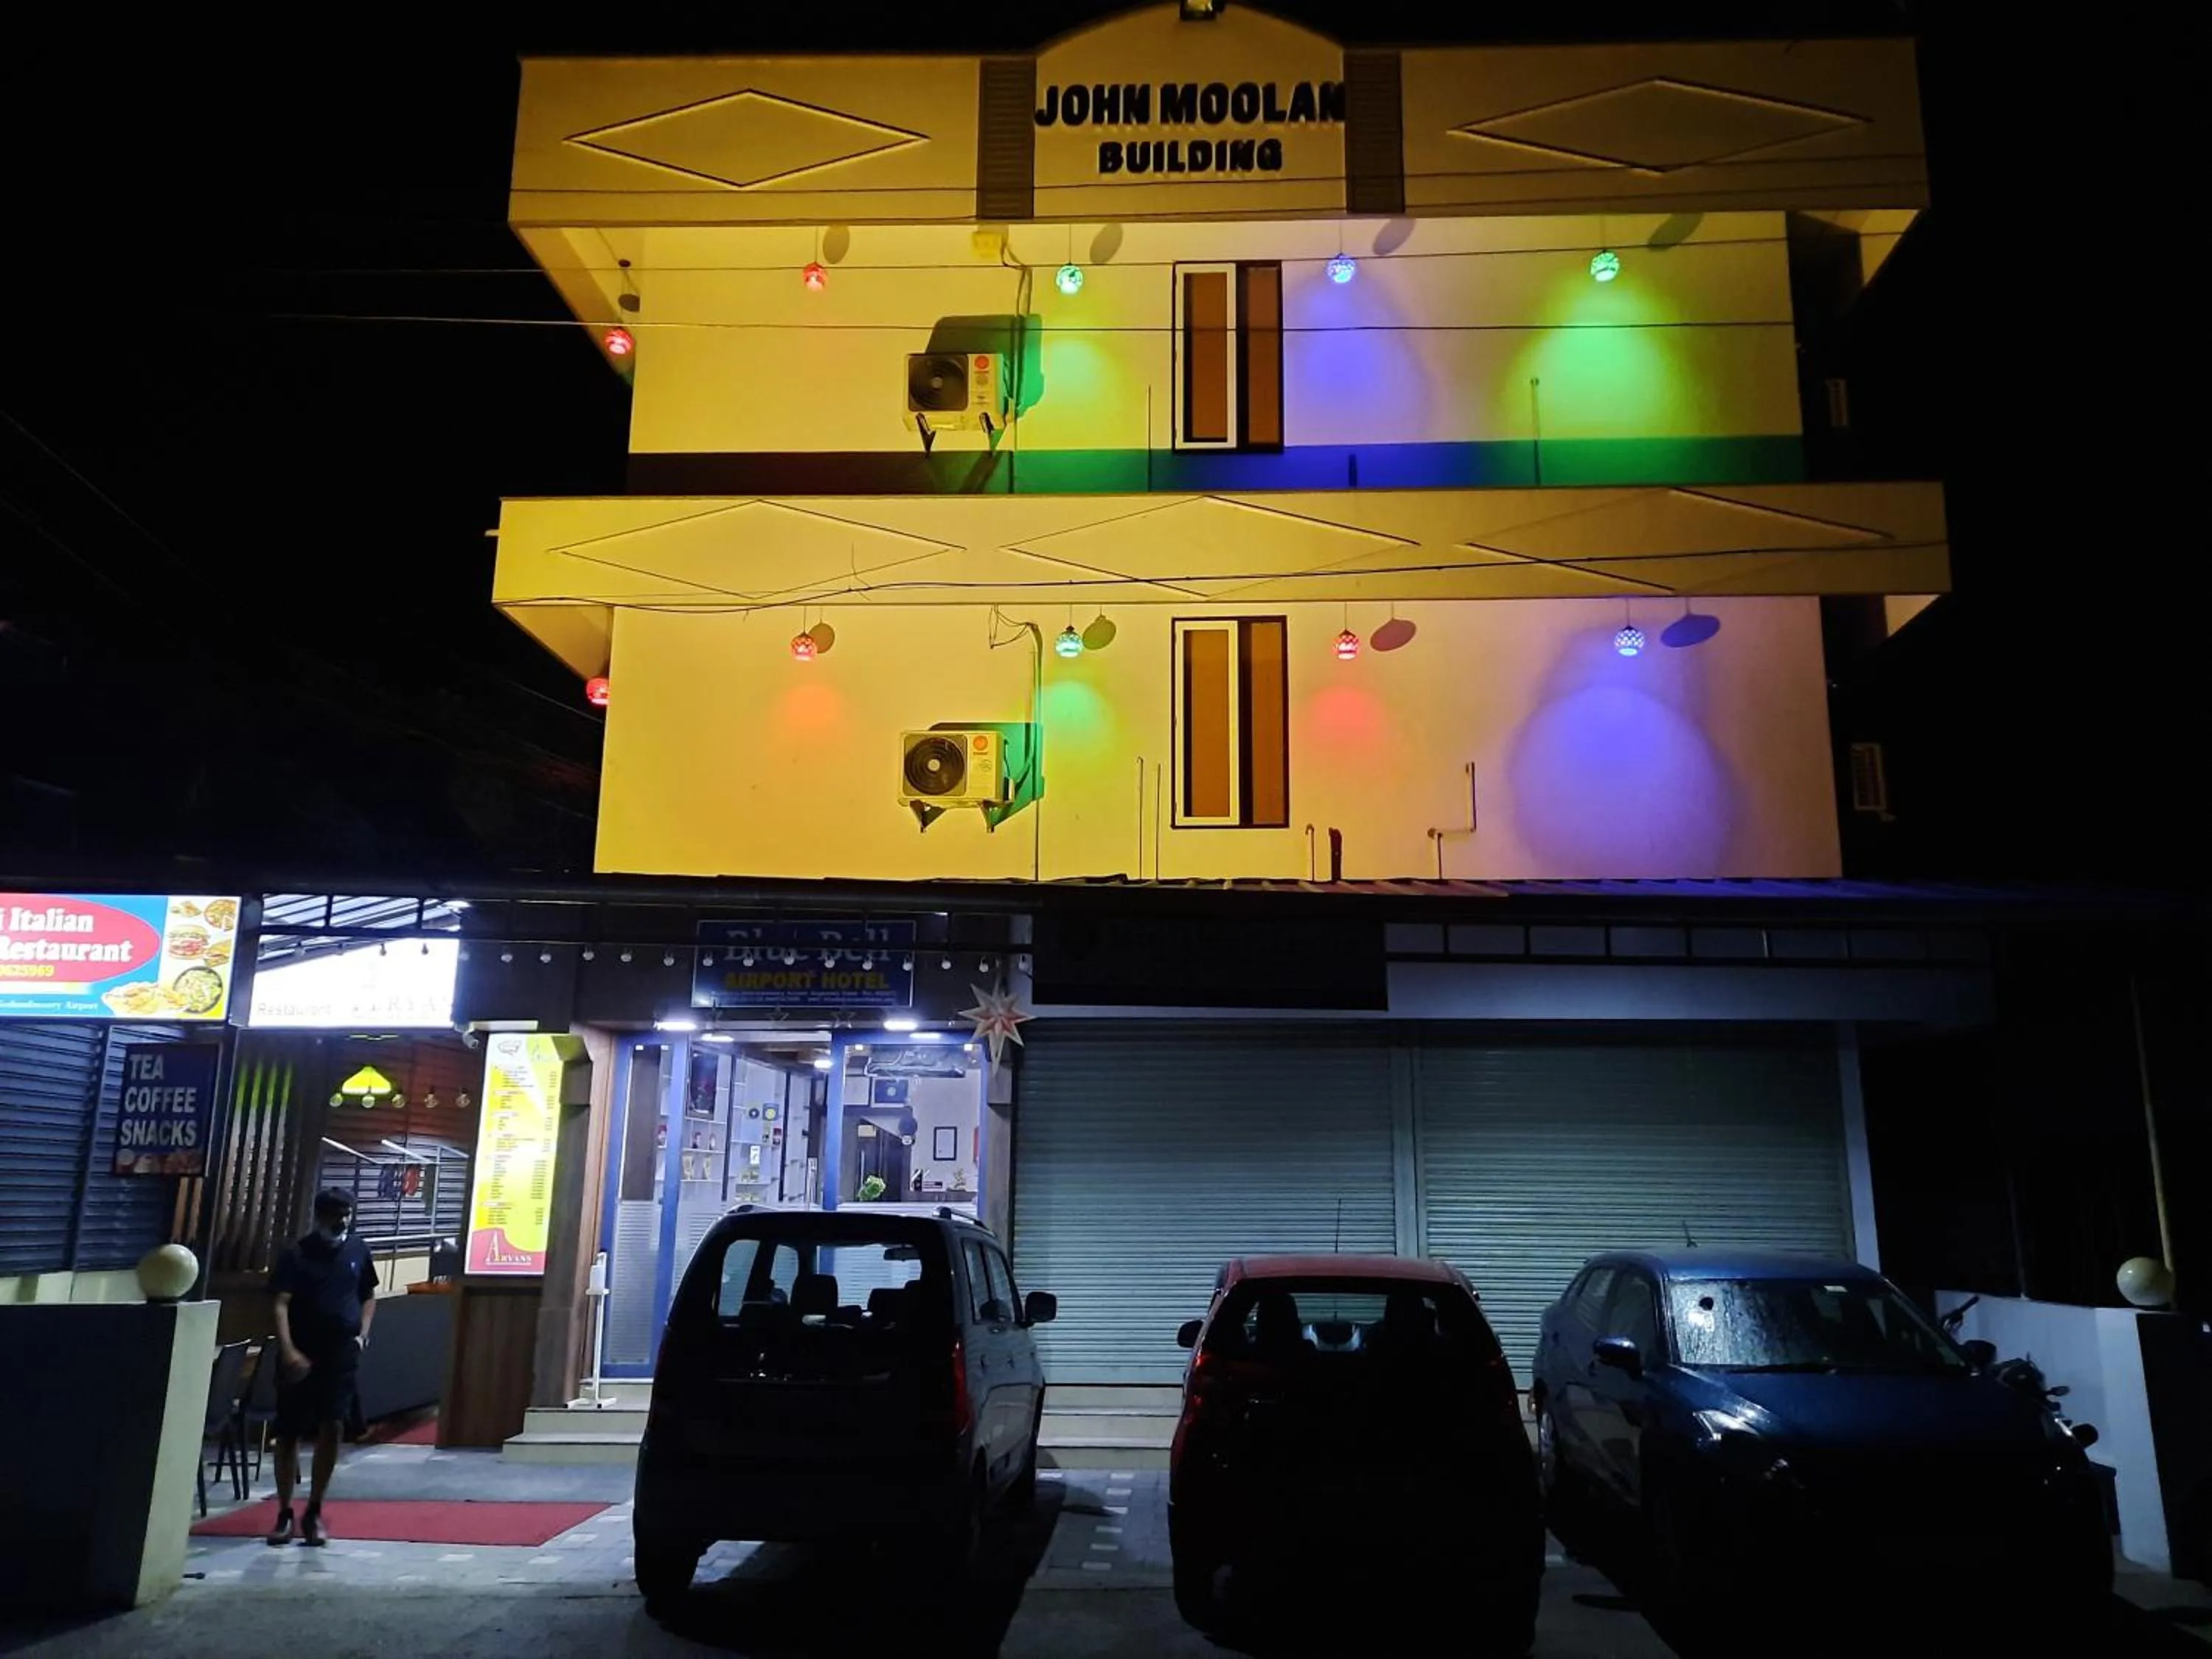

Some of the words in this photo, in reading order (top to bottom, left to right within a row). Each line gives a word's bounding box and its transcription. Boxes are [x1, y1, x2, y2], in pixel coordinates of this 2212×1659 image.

[1034, 83, 1150, 126] JOHN
[1160, 82, 1346, 124] MOOLAN
[1098, 138, 1282, 174] BUILDING
[9, 906, 94, 932] Italian
[724, 971, 815, 990] AIRPORT
[821, 971, 891, 990] HOTEL
[129, 1054, 164, 1080] TEA
[124, 1086, 198, 1113] COFFEE
[119, 1119, 198, 1147] SNACKS
